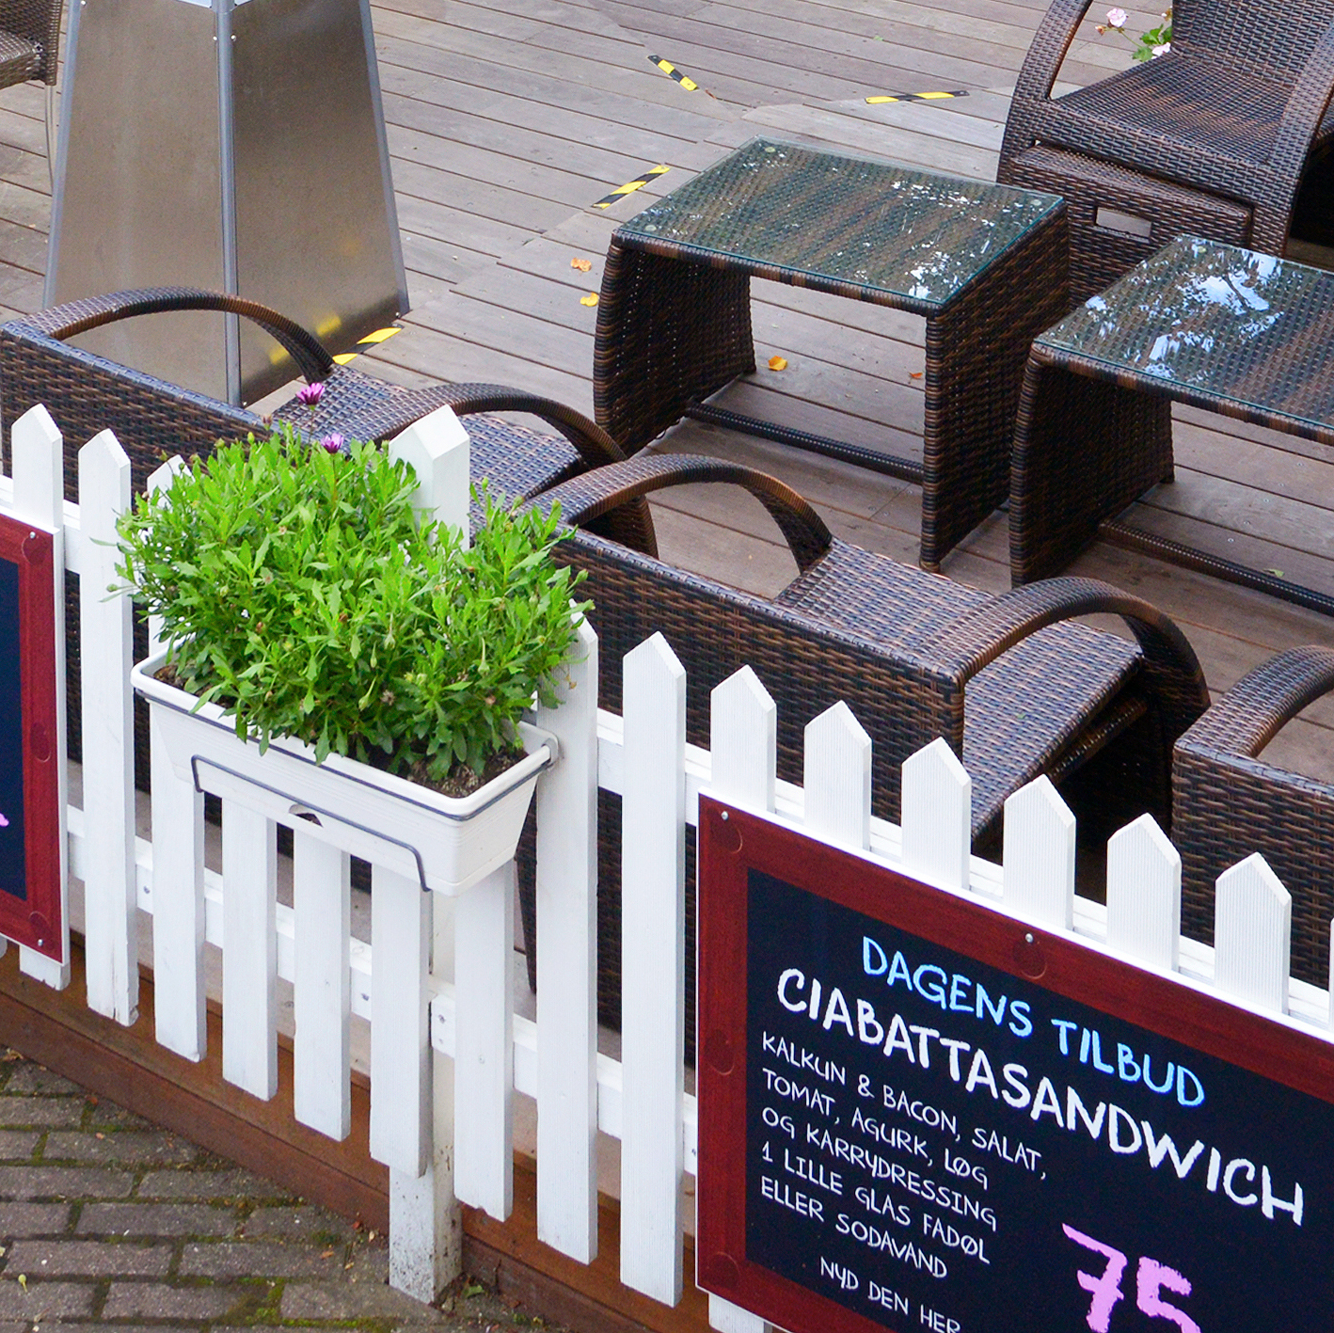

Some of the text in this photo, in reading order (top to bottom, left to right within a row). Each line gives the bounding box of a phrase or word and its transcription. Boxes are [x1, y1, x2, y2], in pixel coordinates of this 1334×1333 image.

[863, 936, 1206, 1106] DAGENS TILBUD
[762, 1067, 988, 1191] TOMAT, AGURK, LØG
[763, 1031, 1047, 1181] KALKUN & BACON, SALAT,
[777, 968, 1305, 1227] CIABATTASANDWICH
[761, 1175, 948, 1279] ELLER SODAVAND
[762, 1107, 997, 1232] OG KARRYDRESSING
[762, 1141, 990, 1265] 1 LILLE GLAS FADØL
[820, 1256, 961, 1333] NYD DEN HER
